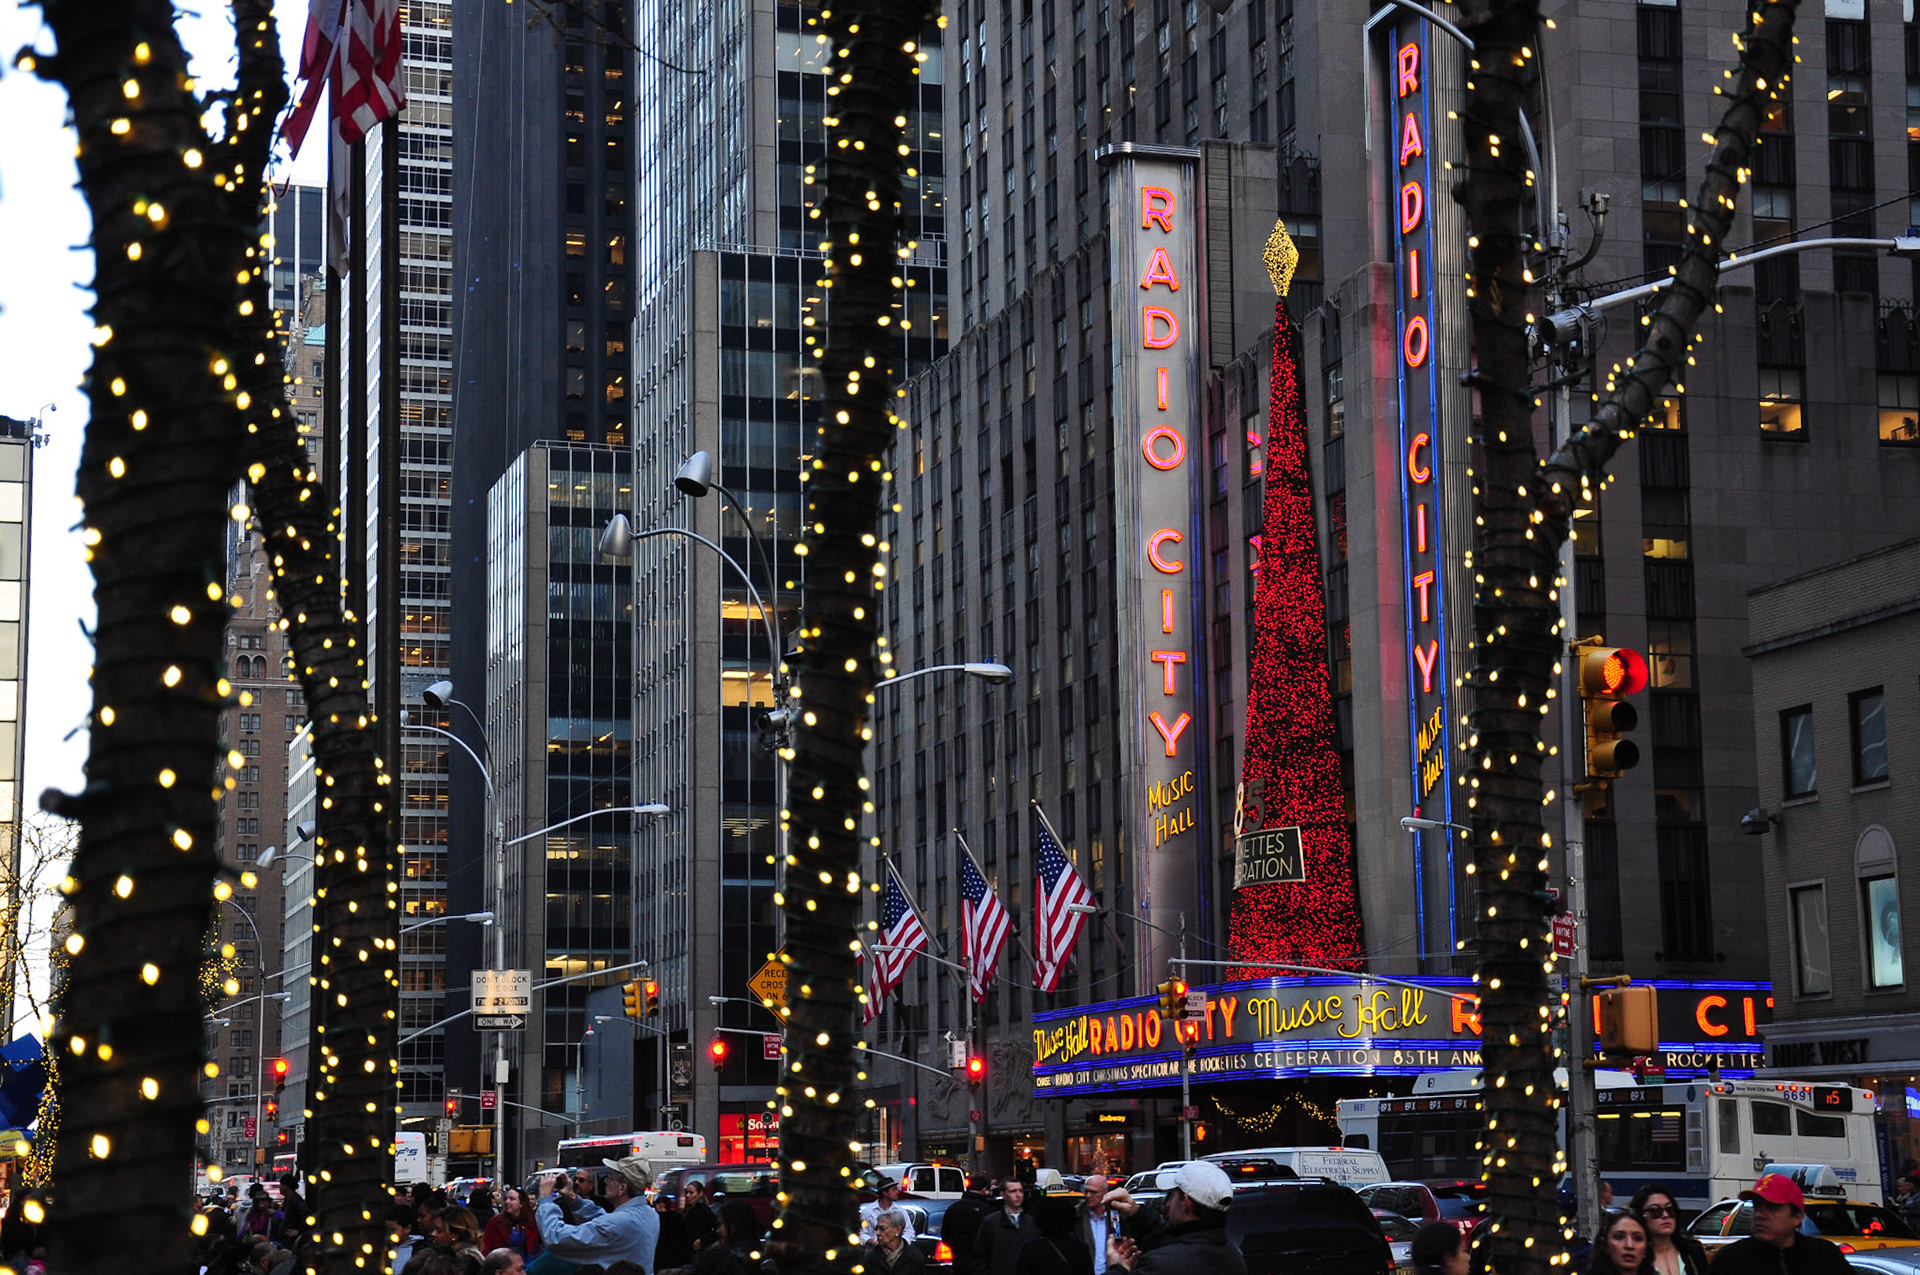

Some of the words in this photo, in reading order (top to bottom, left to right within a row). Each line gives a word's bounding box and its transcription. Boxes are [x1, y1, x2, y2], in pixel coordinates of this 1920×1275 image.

[1399, 42, 1429, 368] RADIO
[1139, 185, 1186, 471] RADIO
[1408, 432, 1439, 693] CITY
[1147, 527, 1192, 758] CITY
[1234, 777, 1265, 836] 85
[501, 976, 527, 984] BLOCK
[481, 1018, 497, 1026] ONE
[1247, 994, 1343, 1039] Music
[1337, 987, 1429, 1039] Hall
[1695, 994, 1774, 1037] CI
[1033, 1026, 1064, 1062] Music
[1061, 1015, 1089, 1063] Hall
[1089, 1009, 1161, 1056] RADIO
[1254, 1048, 1380, 1068] CELEBRATION
[1393, 1051, 1439, 1066] 85TH
[1772, 1042, 1815, 1067] NINE
[1819, 1038, 1869, 1065] WEST
[1055, 1072, 1074, 1086] RADIO
[1076, 1071, 1091, 1084] CITY
[1131, 1060, 1180, 1079] SPECTACULAR
[1187, 1058, 1197, 1074] HE
[1783, 1090, 1812, 1101] 6691
[1099, 1114, 1127, 1123] Subway
[1303, 1164, 1351, 1175] ELECTRICAL
[1352, 1165, 1381, 1175] SUPPLY
[1322, 1156, 1358, 1165] FEDERAL
